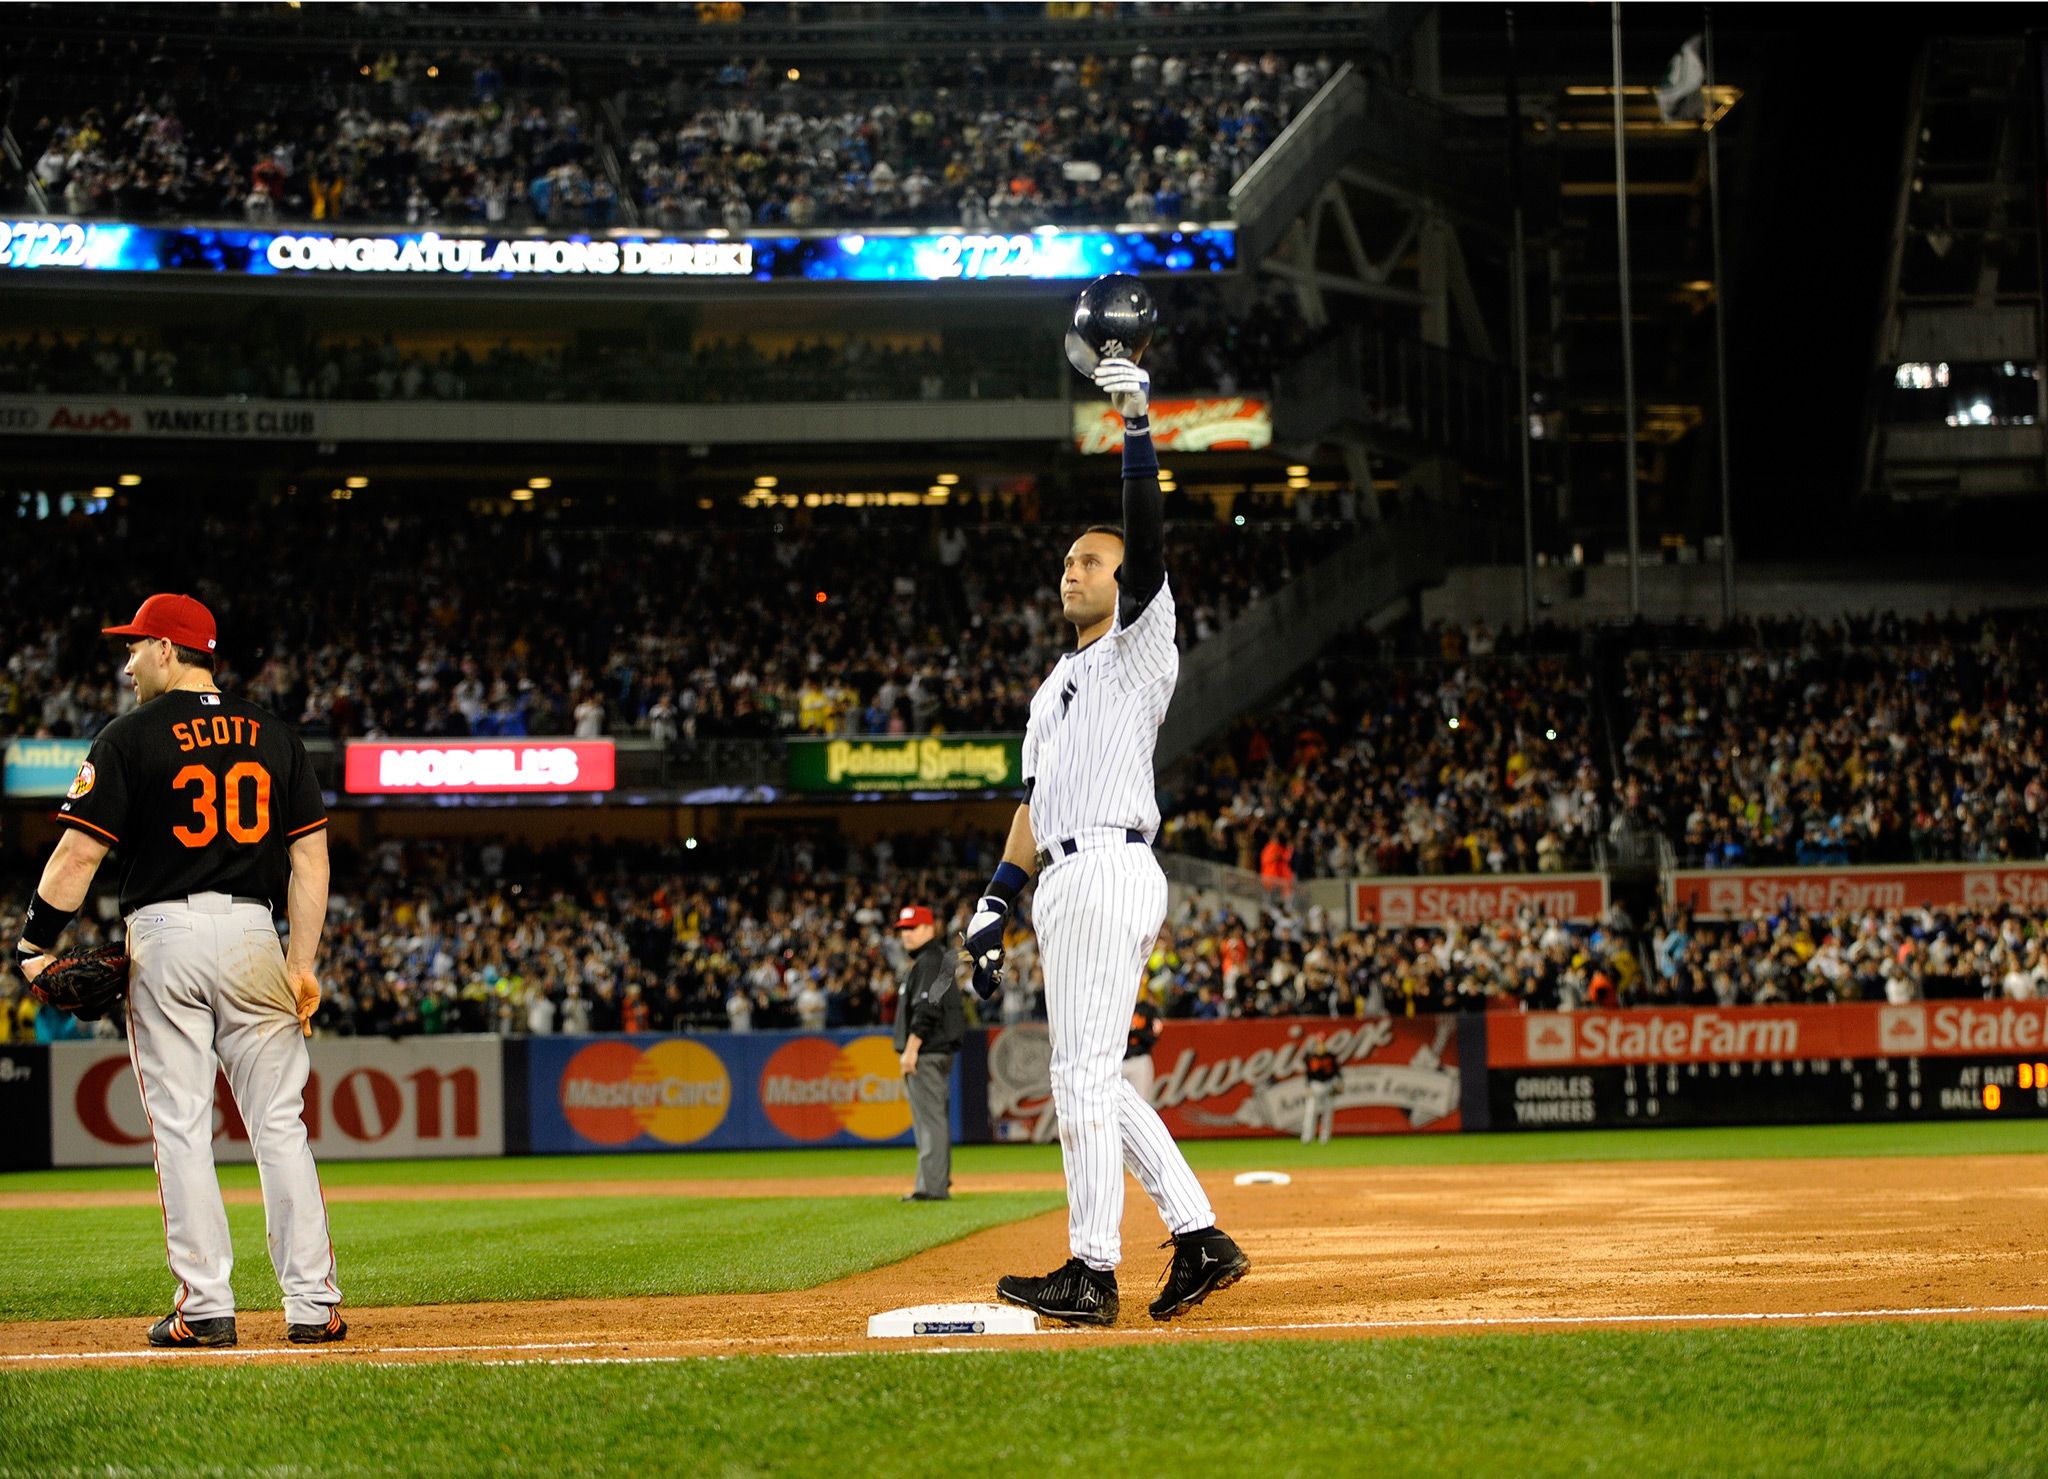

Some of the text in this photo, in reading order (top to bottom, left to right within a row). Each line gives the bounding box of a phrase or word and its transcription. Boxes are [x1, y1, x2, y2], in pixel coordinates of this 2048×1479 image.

[267, 232, 620, 274] CONGRATULATIONS
[937, 235, 1033, 277] 2722
[145, 409, 249, 432] YANKEES
[256, 411, 315, 434] CLUB
[172, 715, 261, 752] SCOTT
[827, 738, 1009, 782] Poland Spring
[172, 761, 271, 847] 30
[567, 1076, 725, 1108] MasterCard
[1515, 1076, 1595, 1100] ORIOLES
[1940, 1088, 1983, 1110] BALL
[1514, 1099, 1596, 1123] YANKEES
